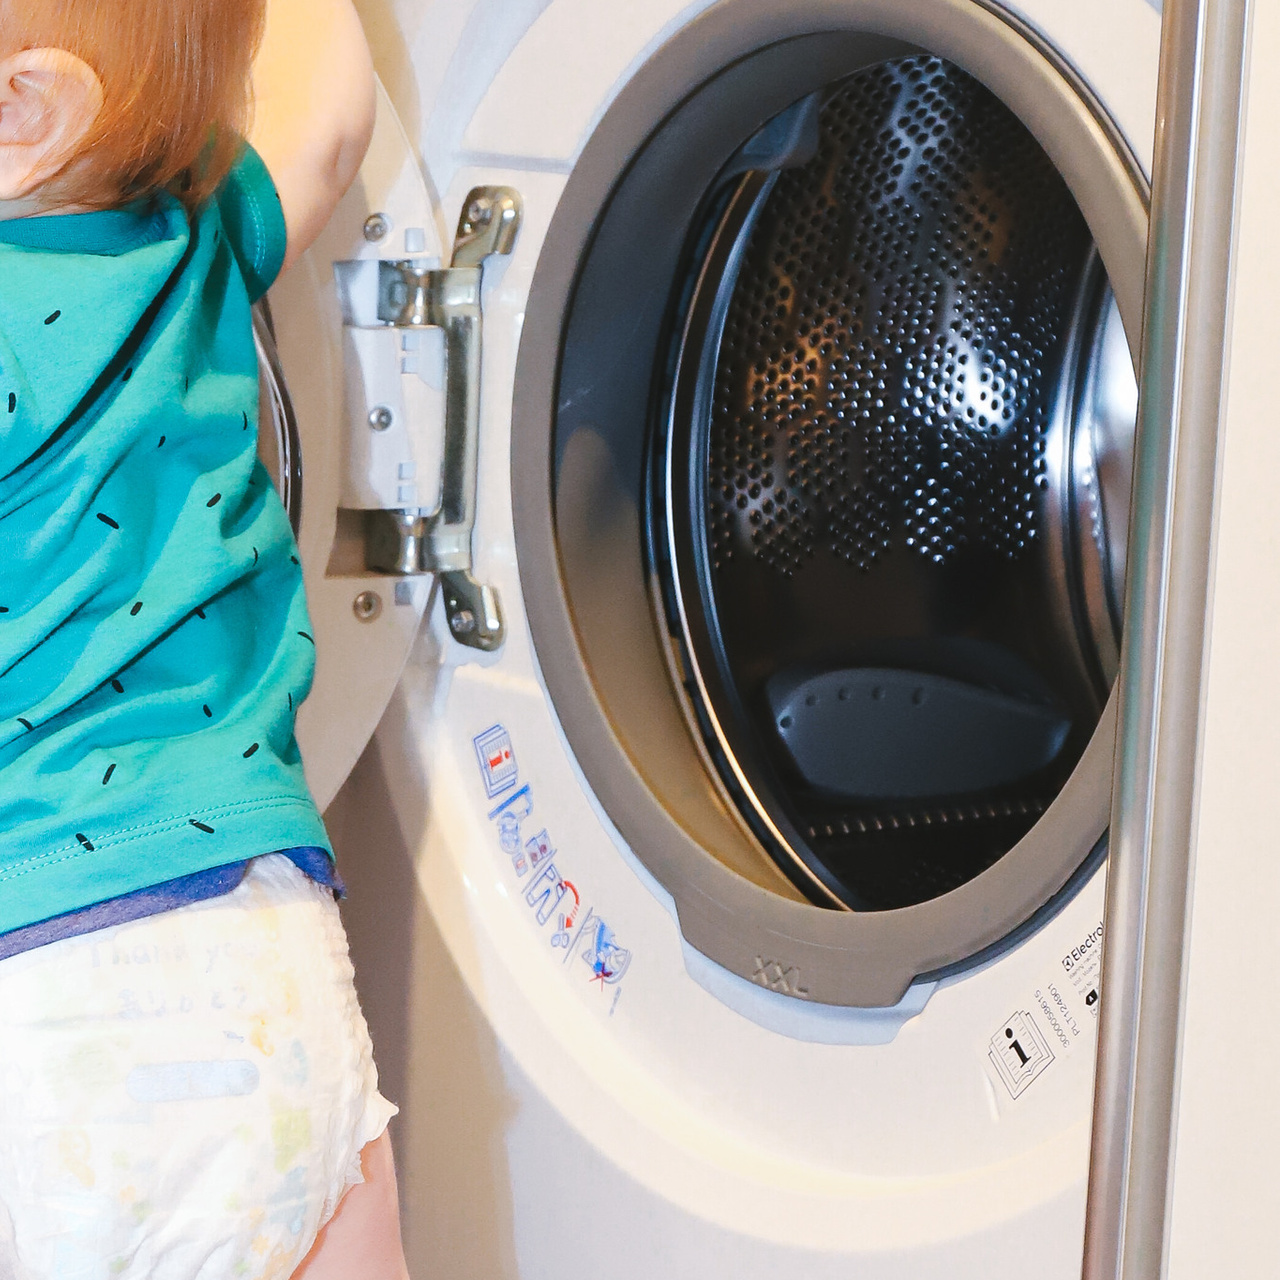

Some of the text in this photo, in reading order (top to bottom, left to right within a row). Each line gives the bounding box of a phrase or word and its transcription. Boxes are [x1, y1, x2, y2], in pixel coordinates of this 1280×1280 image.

[1071, 920, 1105, 962] Electrol
[750, 955, 809, 997] XXL
[1047, 983, 1081, 1037] PLT124901
